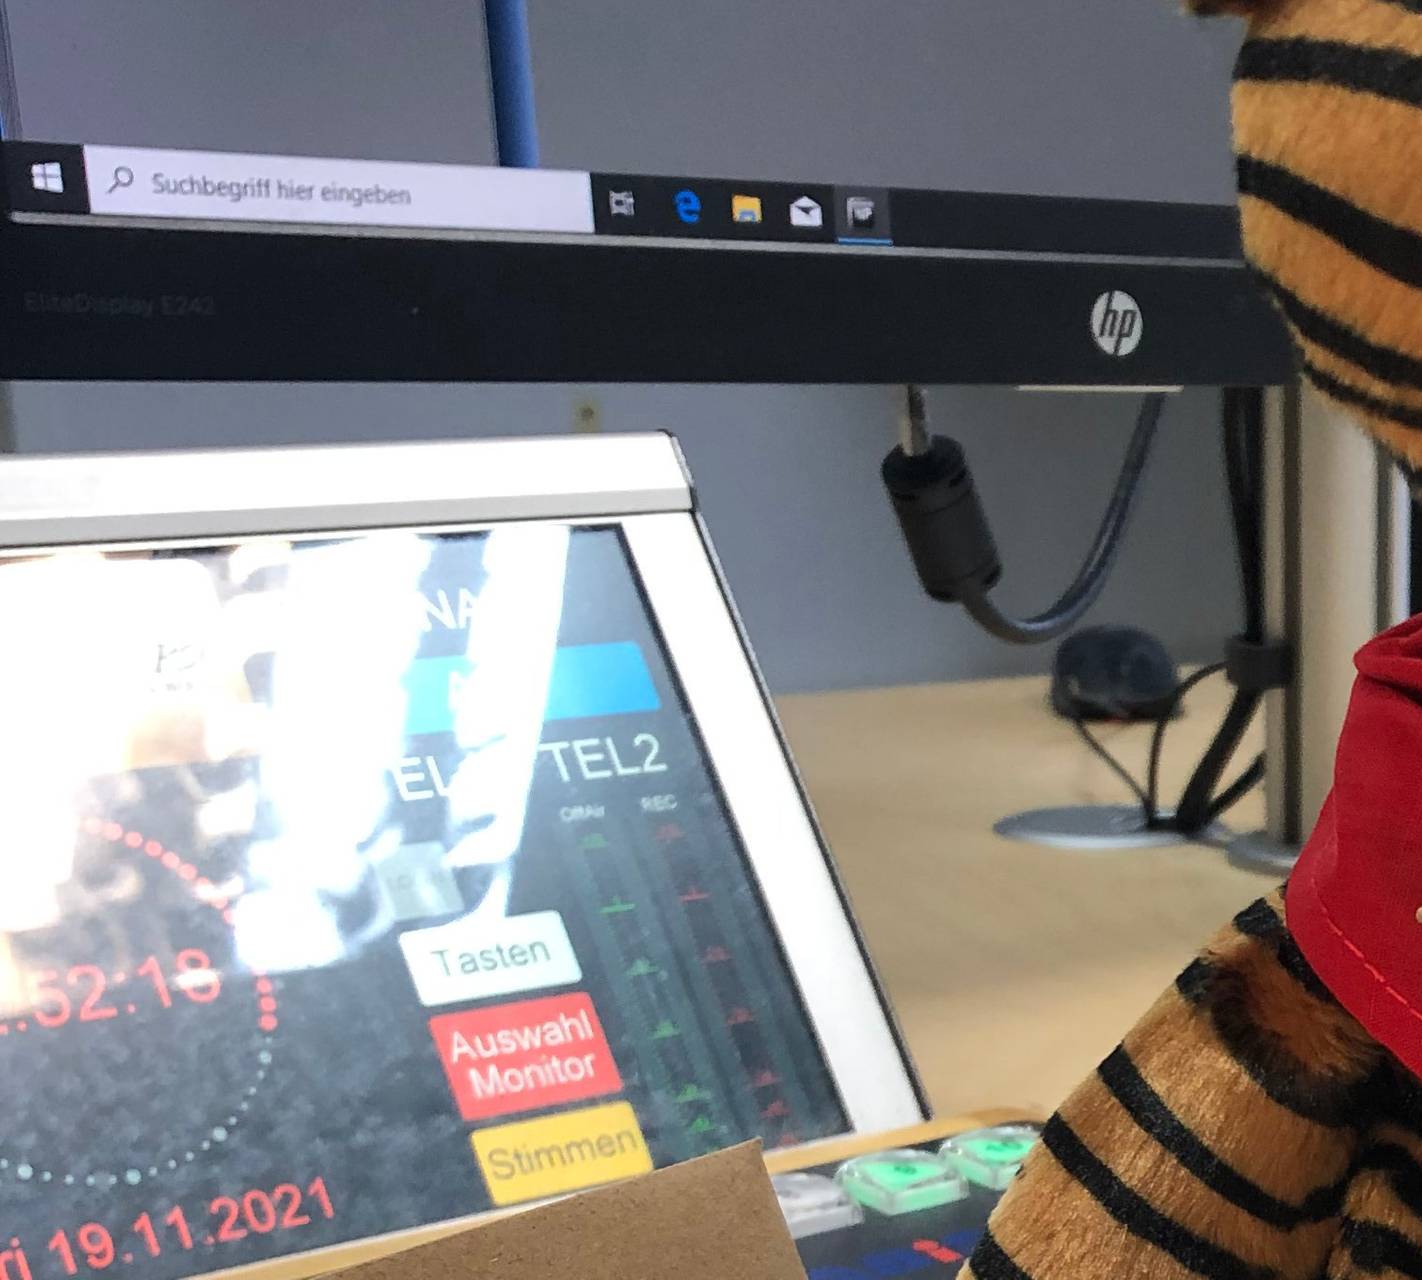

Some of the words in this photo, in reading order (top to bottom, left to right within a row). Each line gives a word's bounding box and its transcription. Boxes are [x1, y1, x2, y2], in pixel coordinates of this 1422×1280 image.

[152, 172, 271, 202] Suchbegriff
[276, 178, 314, 201] hier
[320, 182, 411, 207] eingeben
[1099, 290, 1138, 356] hp
[538, 733, 668, 783] TEL2
[641, 794, 678, 812] REC
[430, 940, 551, 978] Tasten
[451, 1007, 594, 1064] Auswahl
[468, 1053, 596, 1100] Monitor
[487, 1128, 638, 1182] Stimmen
[49, 1176, 335, 1276] 19.11.2021
